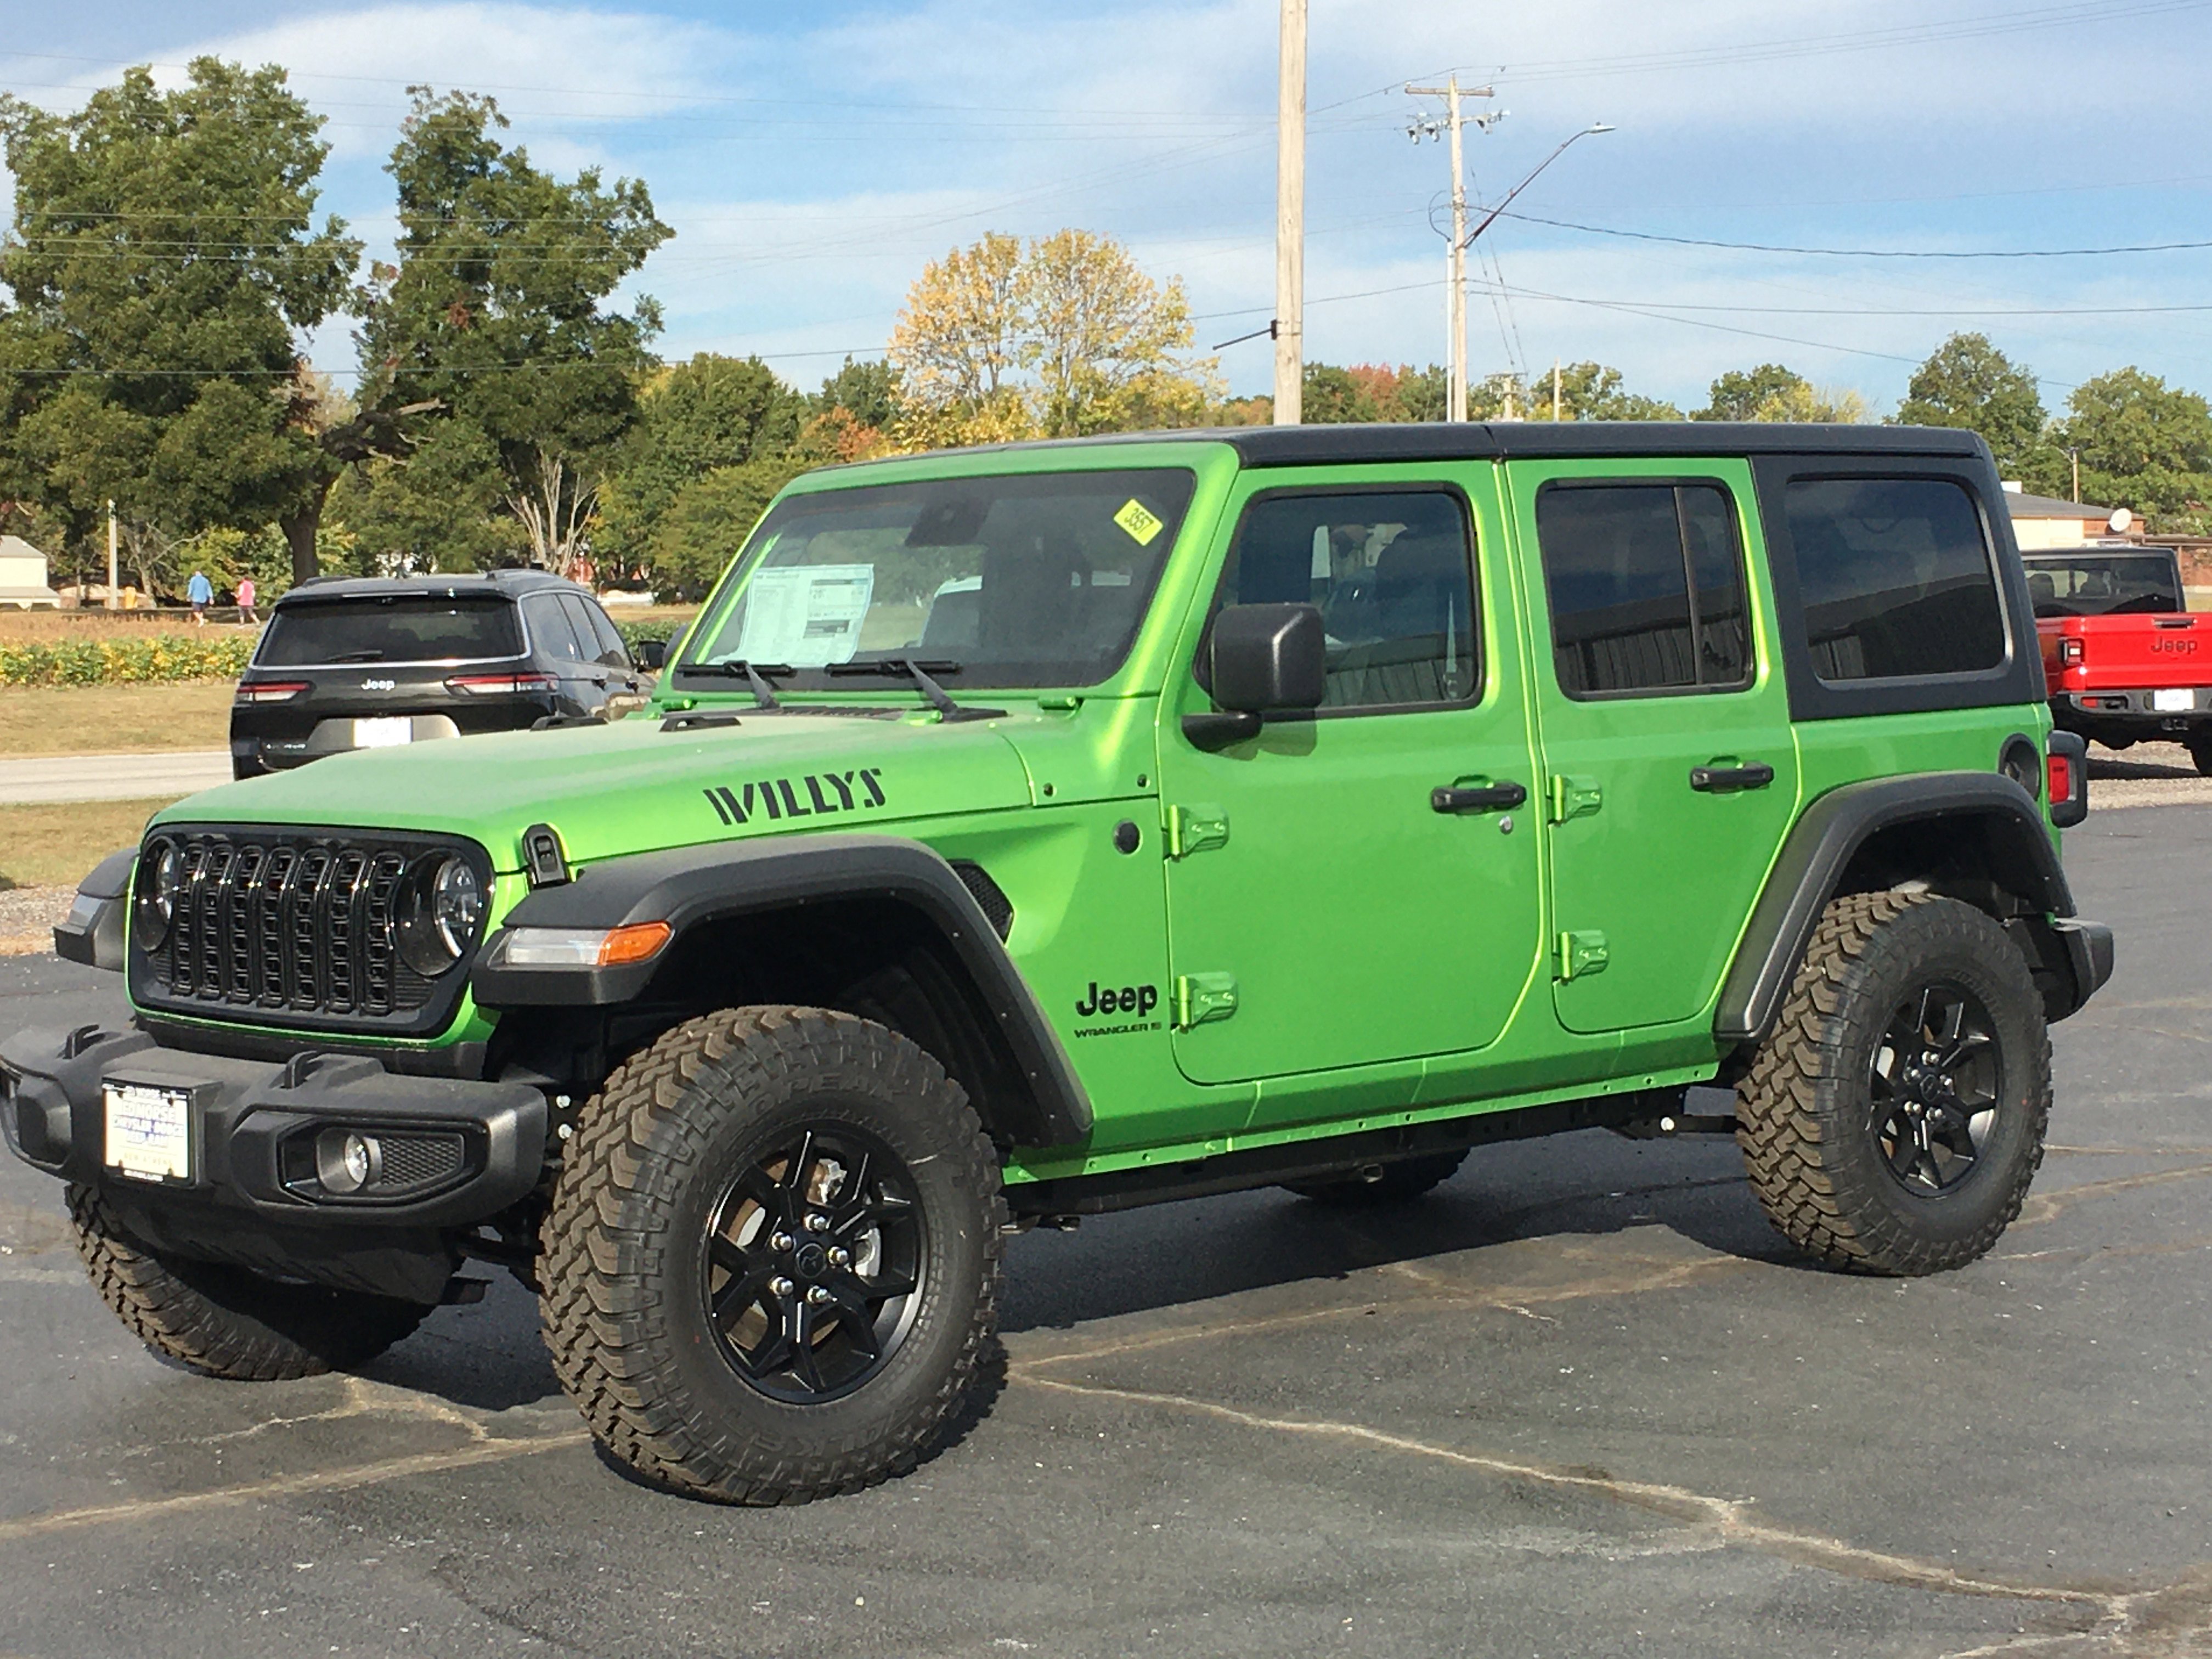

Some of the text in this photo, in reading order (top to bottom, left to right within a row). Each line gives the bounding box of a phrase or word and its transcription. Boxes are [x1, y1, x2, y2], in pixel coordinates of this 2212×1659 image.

[1124, 507, 1154, 534] 3557
[2151, 636, 2197, 654] Jeep
[361, 679, 395, 691] Jeep
[702, 768, 885, 825] WILLYS
[1076, 981, 1157, 1017] Jeep
[1074, 1023, 1148, 1038] WRANGLER
